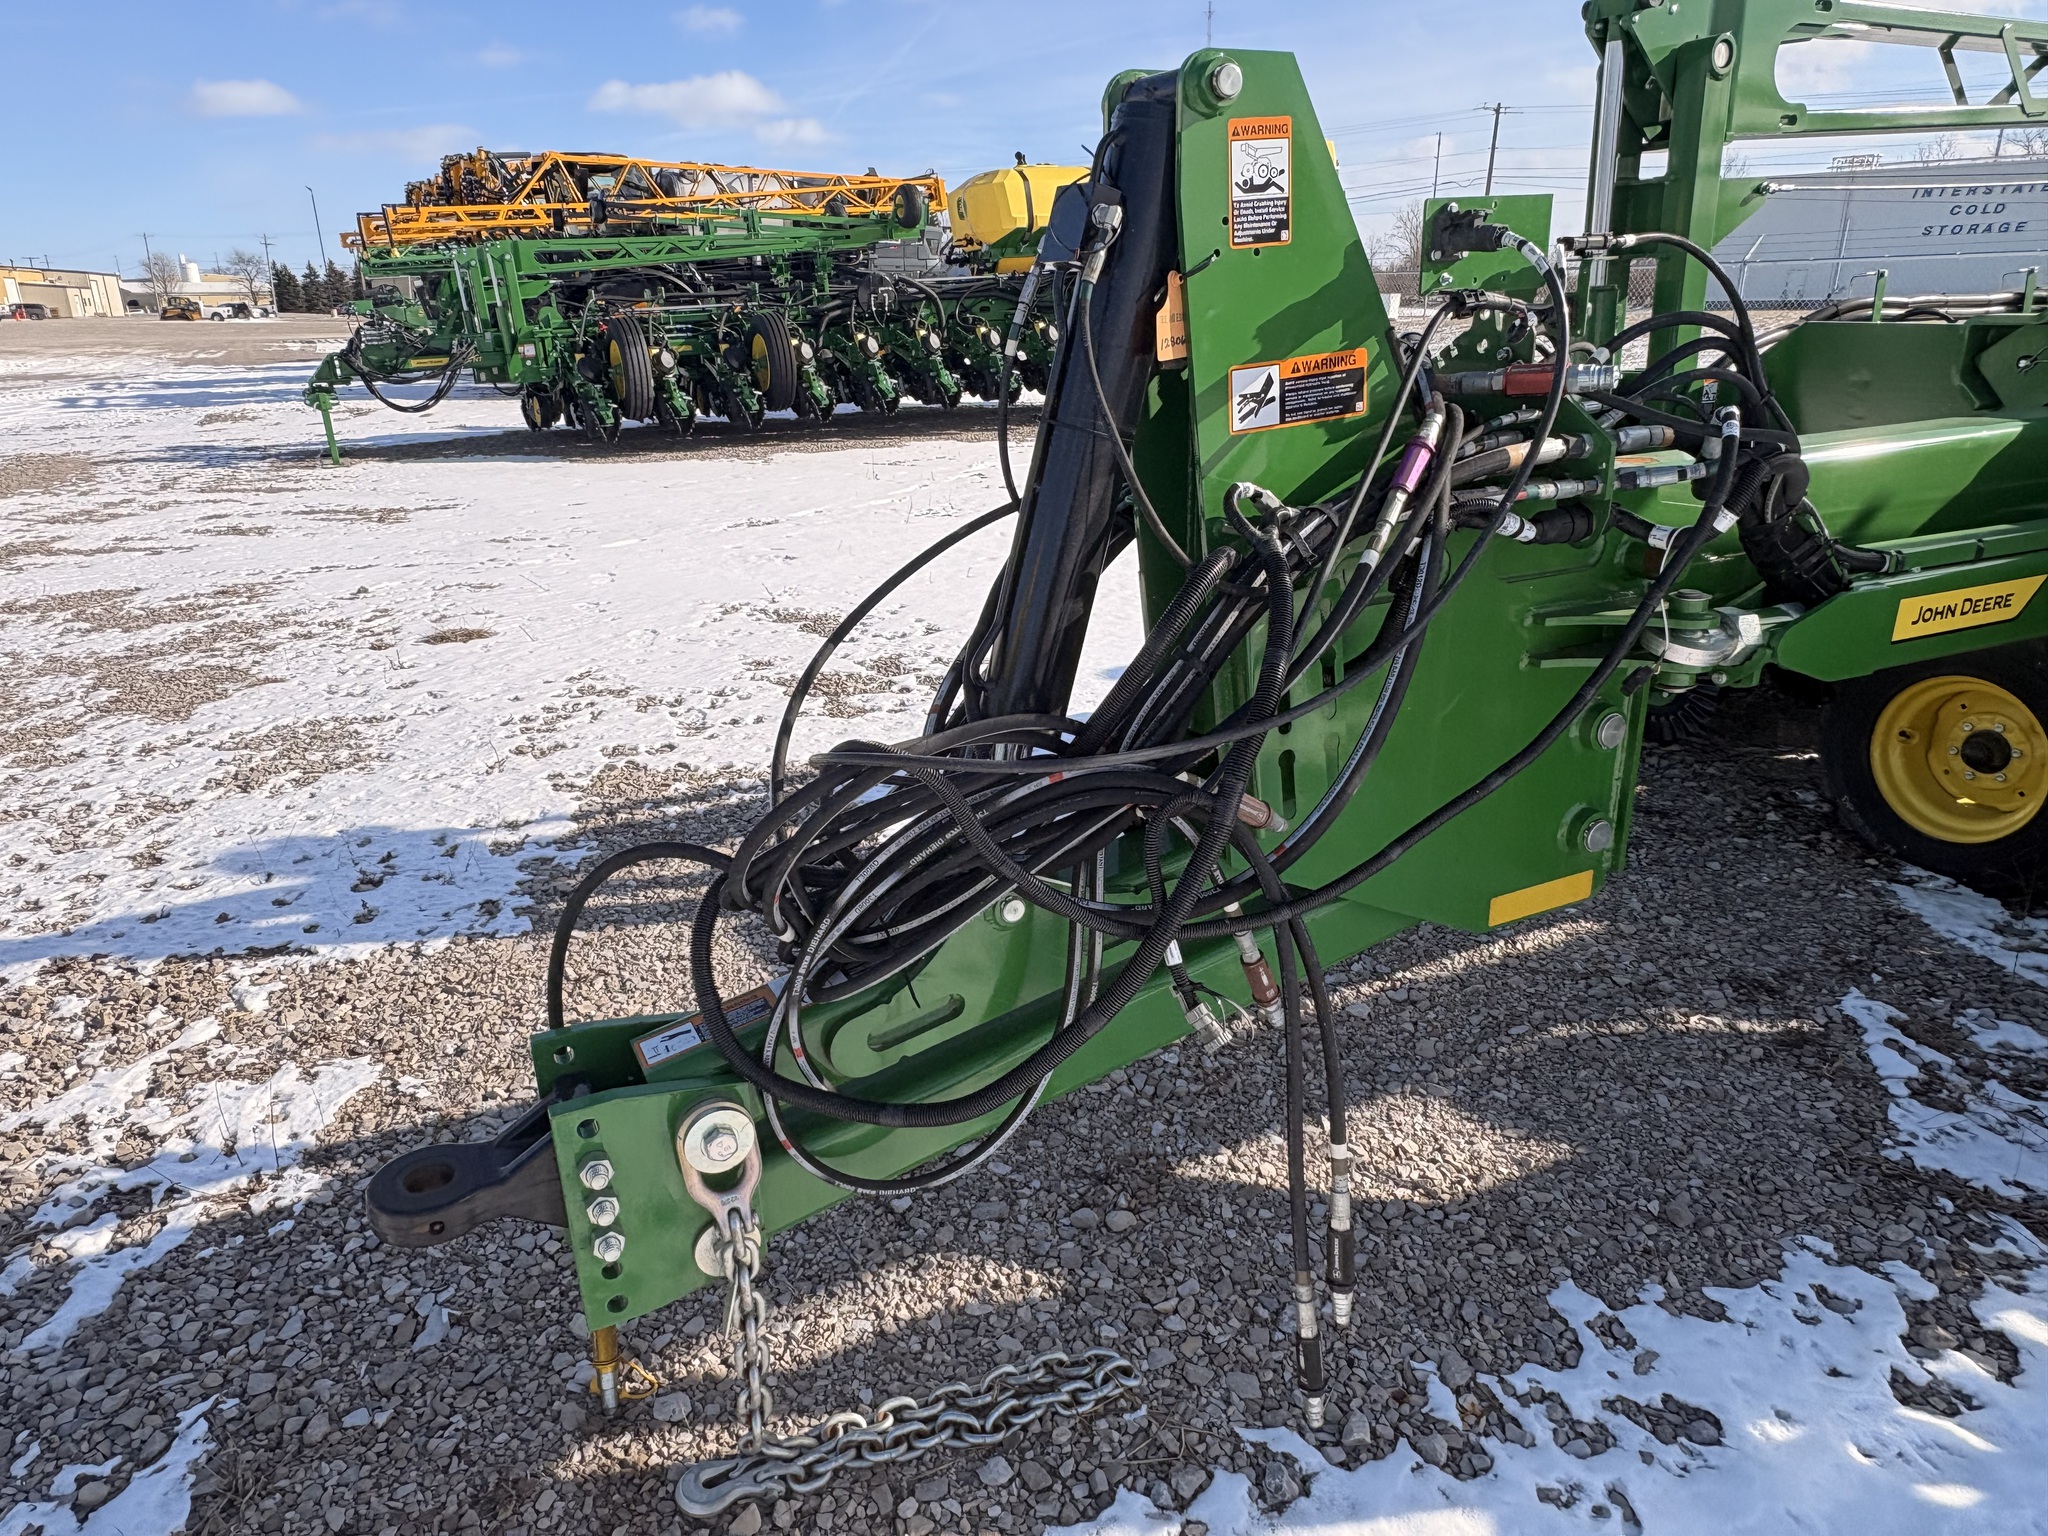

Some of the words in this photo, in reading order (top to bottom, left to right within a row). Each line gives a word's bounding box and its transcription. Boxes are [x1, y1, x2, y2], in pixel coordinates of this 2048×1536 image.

[1240, 123, 1289, 136] WARNING
[1949, 203, 2006, 216] COLD
[1922, 221, 2028, 236] STORAGE
[1301, 354, 1356, 373] WARNING
[1911, 603, 1958, 626] JOHN
[1960, 592, 2015, 616] DEERE
[910, 832, 945, 864] DIEHARD
[807, 918, 830, 953] DIEHARD
[878, 1186, 915, 1196] DIEHARD
